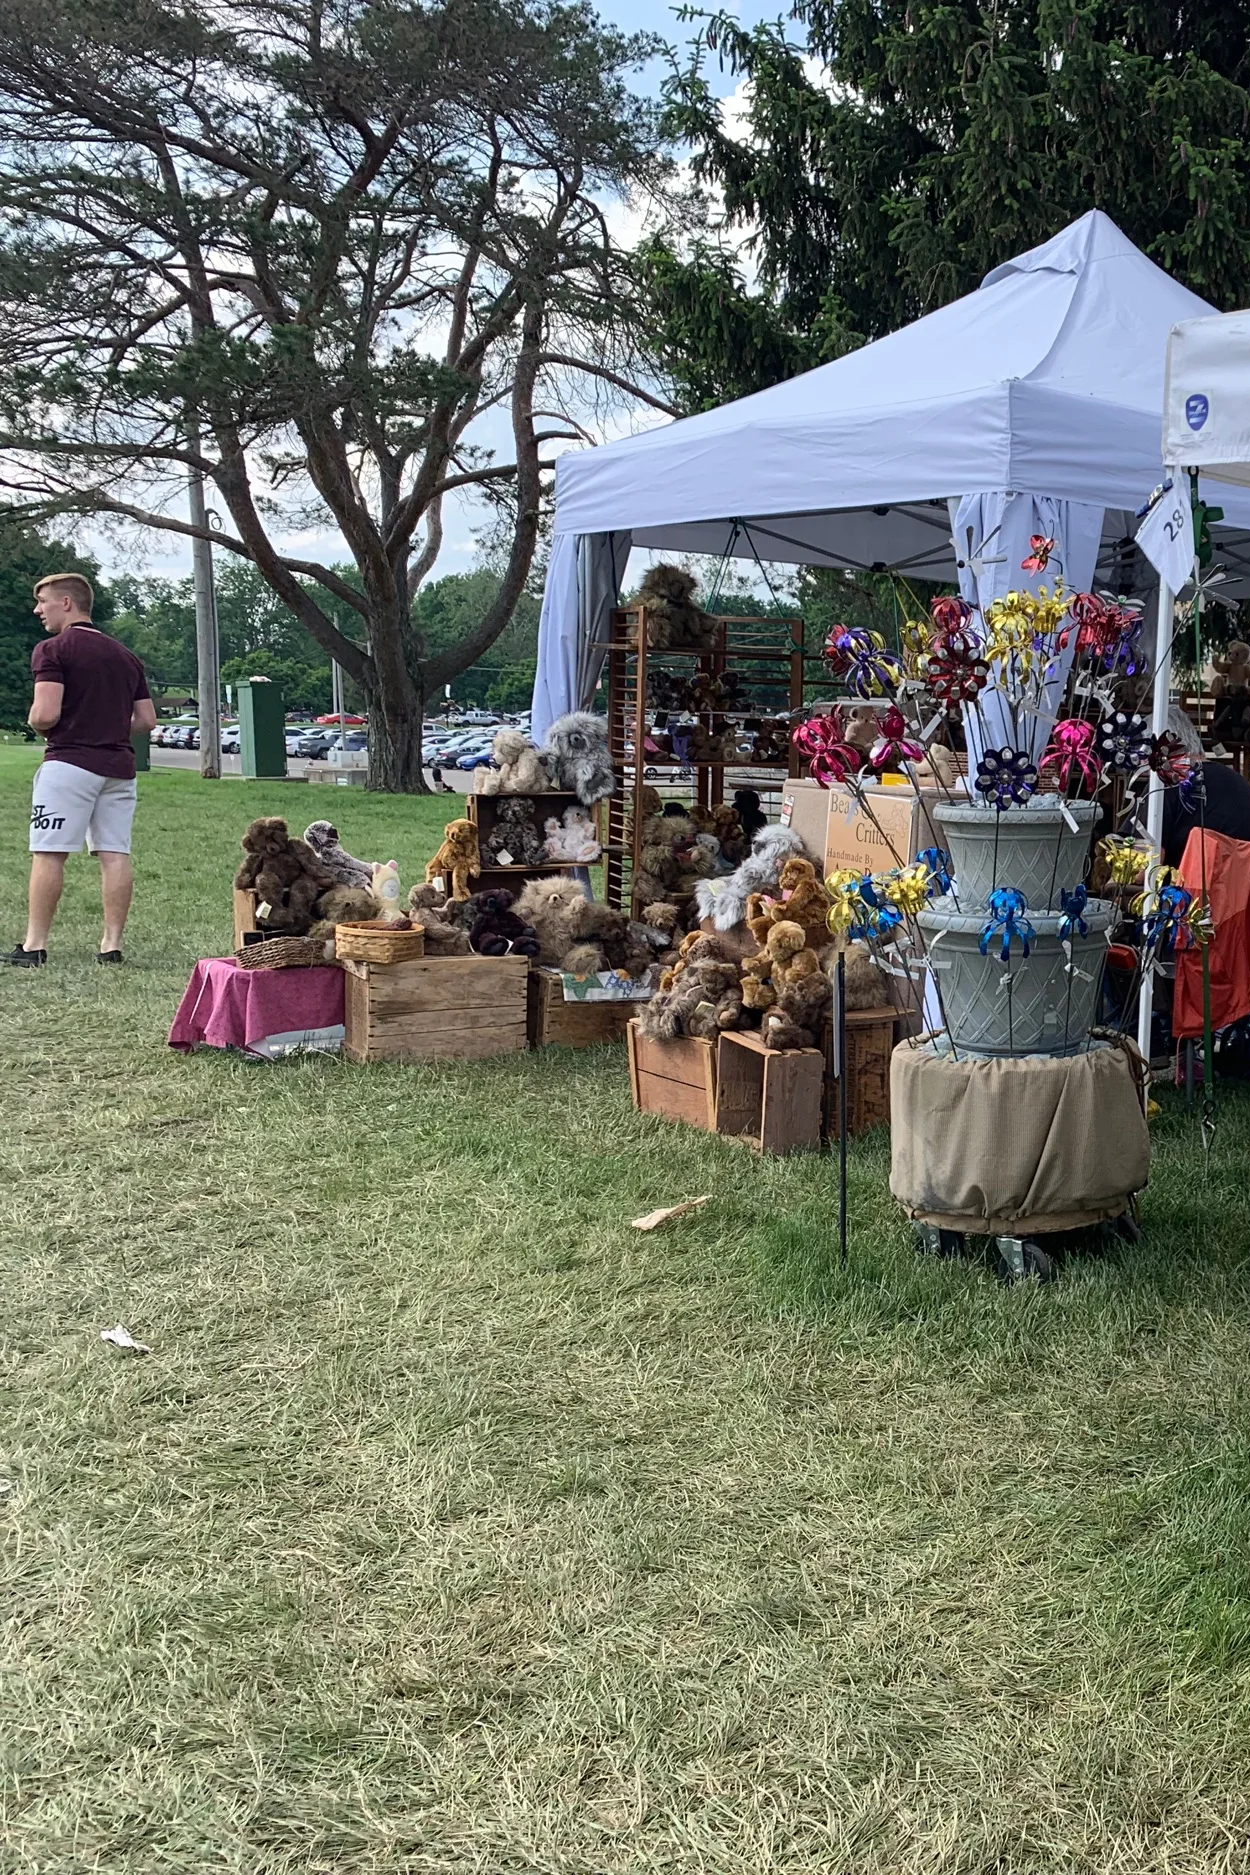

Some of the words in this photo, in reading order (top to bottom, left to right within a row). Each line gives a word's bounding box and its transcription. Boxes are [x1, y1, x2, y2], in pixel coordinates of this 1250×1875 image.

[831, 793, 859, 817] Beas
[34, 818, 50, 830] DO
[51, 818, 66, 830] IT
[856, 822, 895, 847] Critters
[827, 847, 863, 863] Handmade
[864, 853, 875, 867] By
